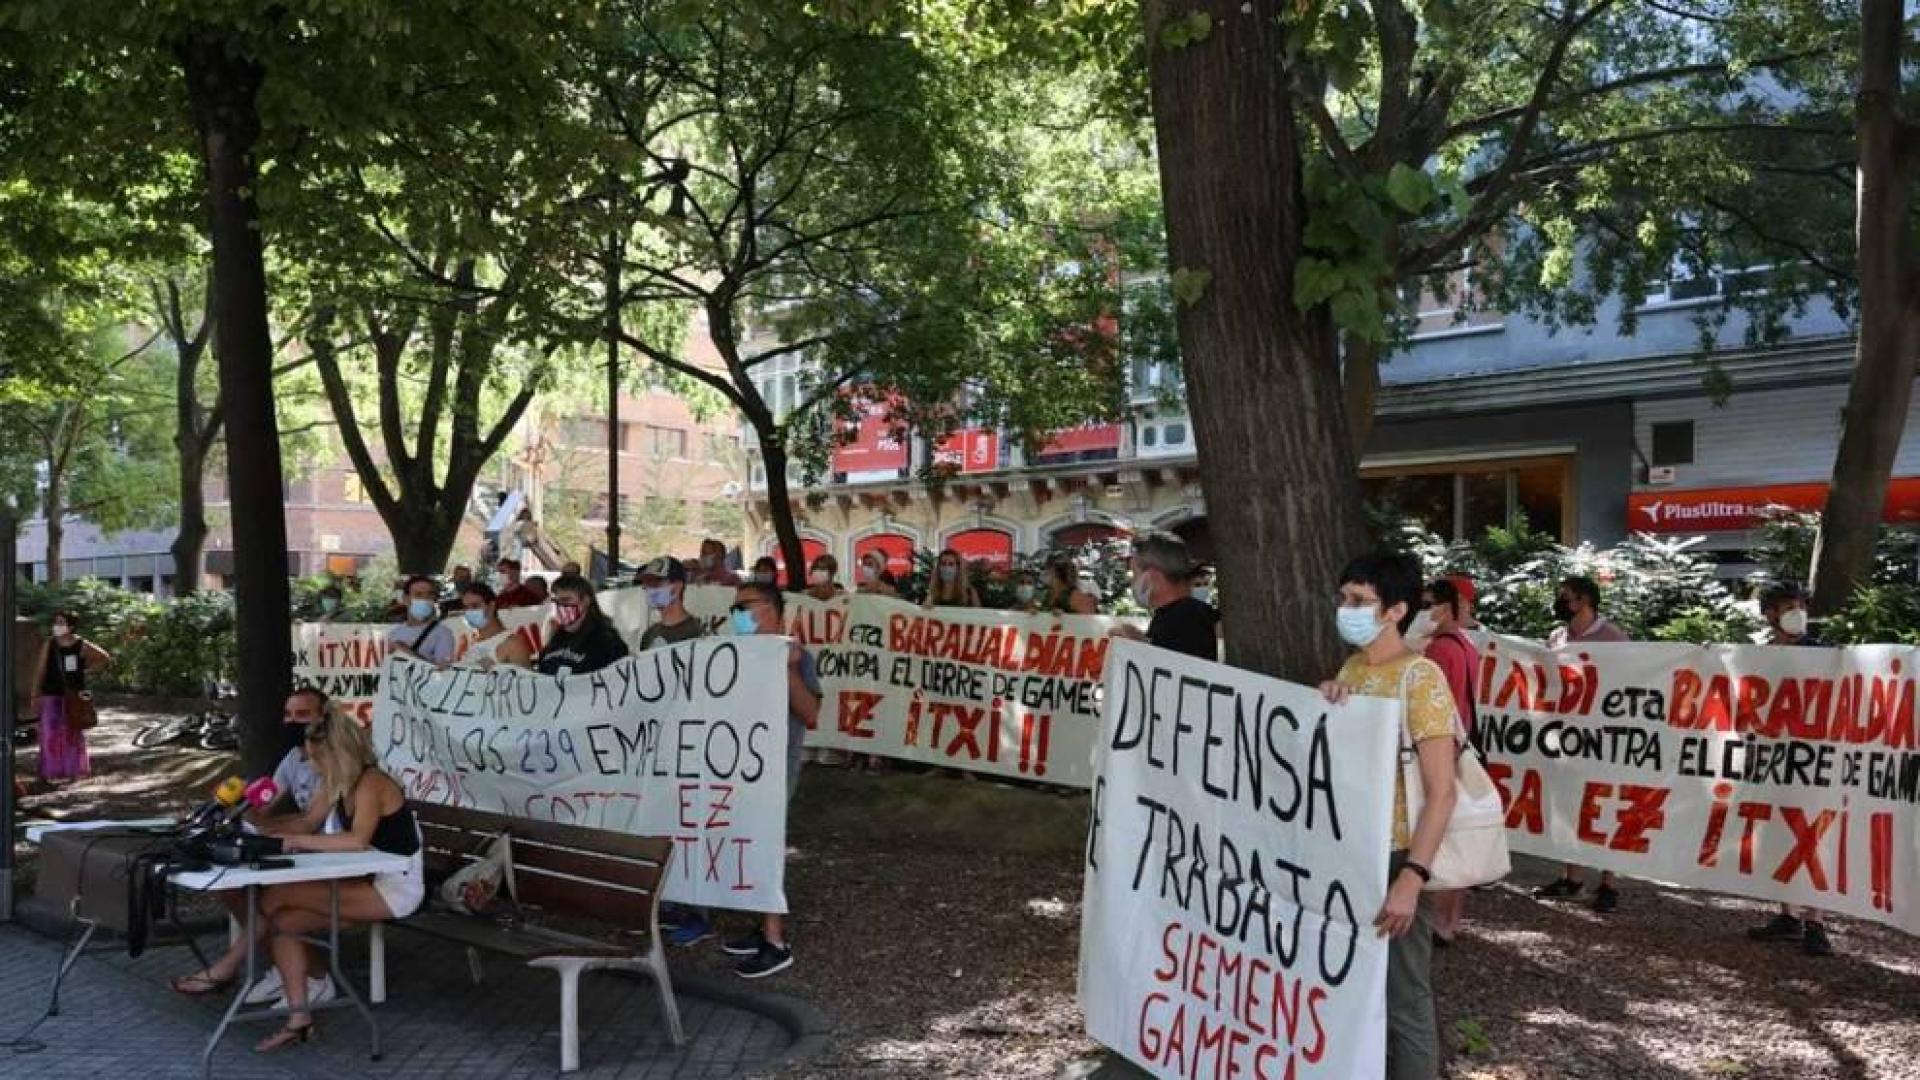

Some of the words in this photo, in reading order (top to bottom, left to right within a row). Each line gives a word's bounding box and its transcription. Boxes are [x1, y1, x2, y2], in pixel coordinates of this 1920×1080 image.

[1664, 501, 1744, 519] PlusUltra
[553, 672, 567, 720] Y
[589, 642, 739, 710] AYUNO
[890, 655, 916, 688] EL
[992, 674, 1019, 702] DE
[446, 724, 509, 775] LOS
[514, 727, 582, 775] 239
[586, 718, 770, 783] EMPLEOS
[1110, 659, 1342, 841] DEFENSA
[1536, 719, 1662, 772] CONTRA
[1678, 736, 1715, 777] EL
[1841, 751, 1863, 786] DE
[678, 784, 733, 830] EZ
[1577, 780, 1671, 853] EZ
[1131, 795, 1359, 986] TRABAJO
[1154, 921, 1328, 1064] SIEMENS
